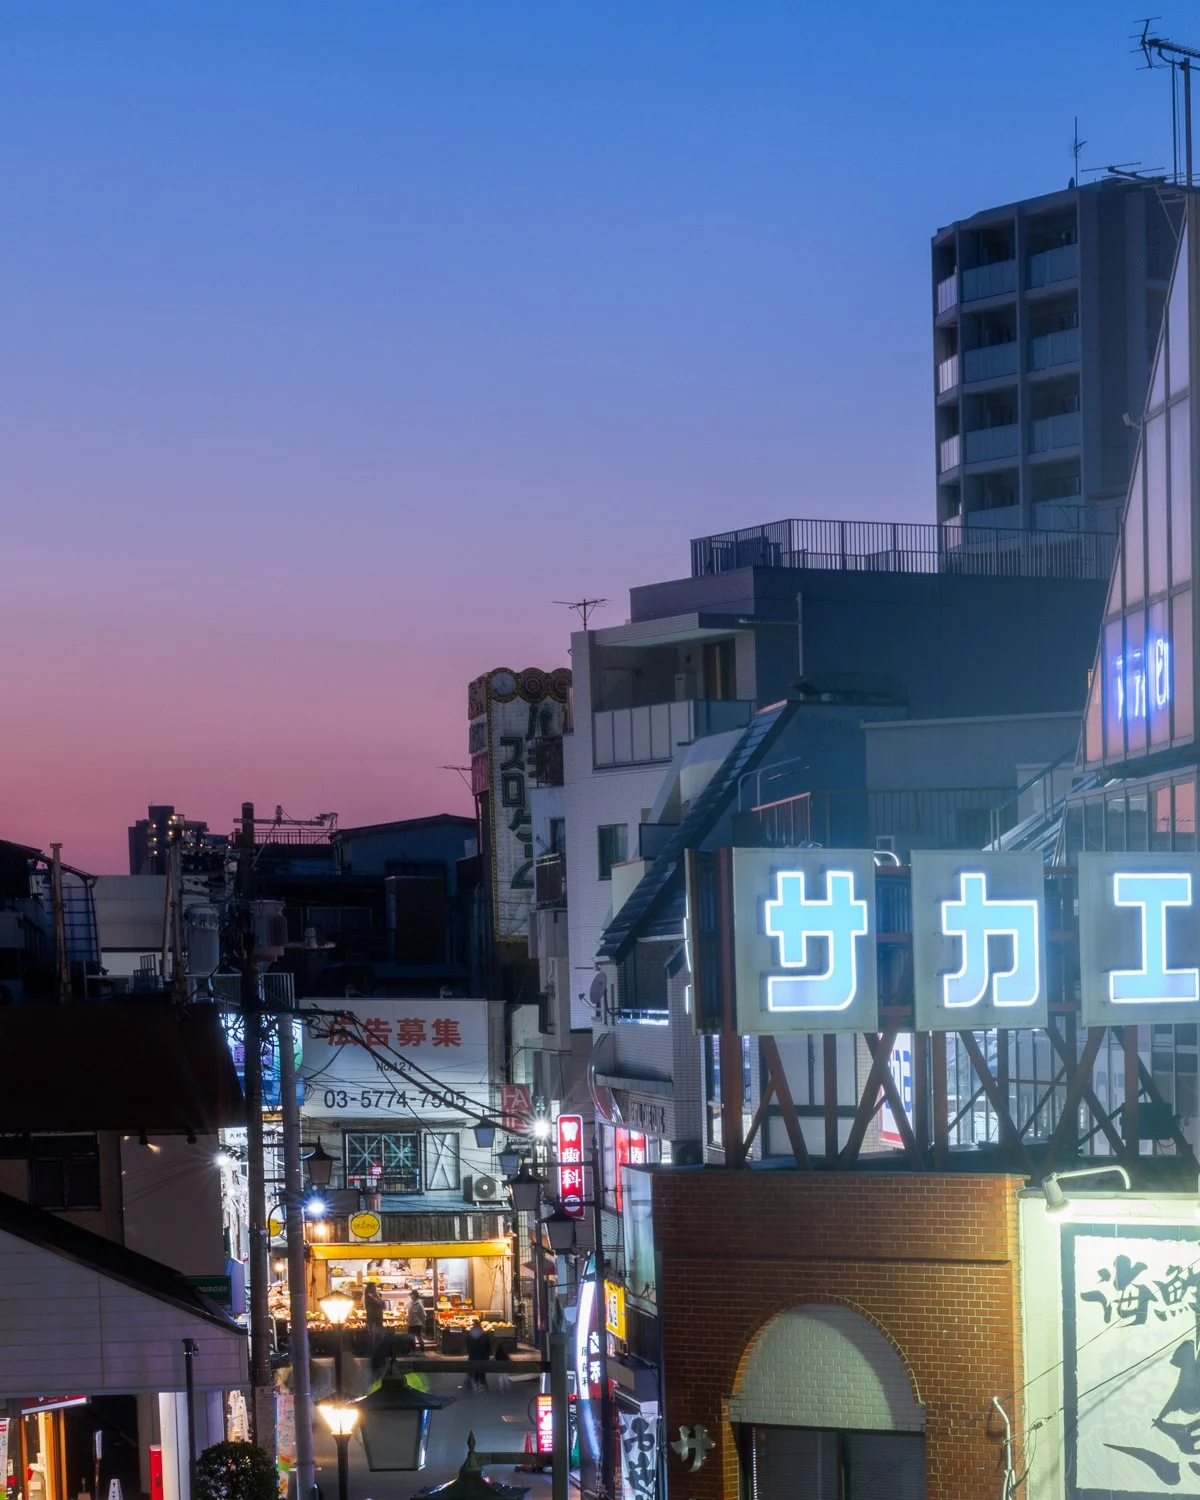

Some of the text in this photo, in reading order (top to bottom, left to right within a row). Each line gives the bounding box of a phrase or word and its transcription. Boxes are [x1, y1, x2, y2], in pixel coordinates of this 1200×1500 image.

[327, 1017, 462, 1047] 広告募集
[323, 1090, 467, 1109] 03-5774-7505
[561, 1147, 582, 1189] 歯科
